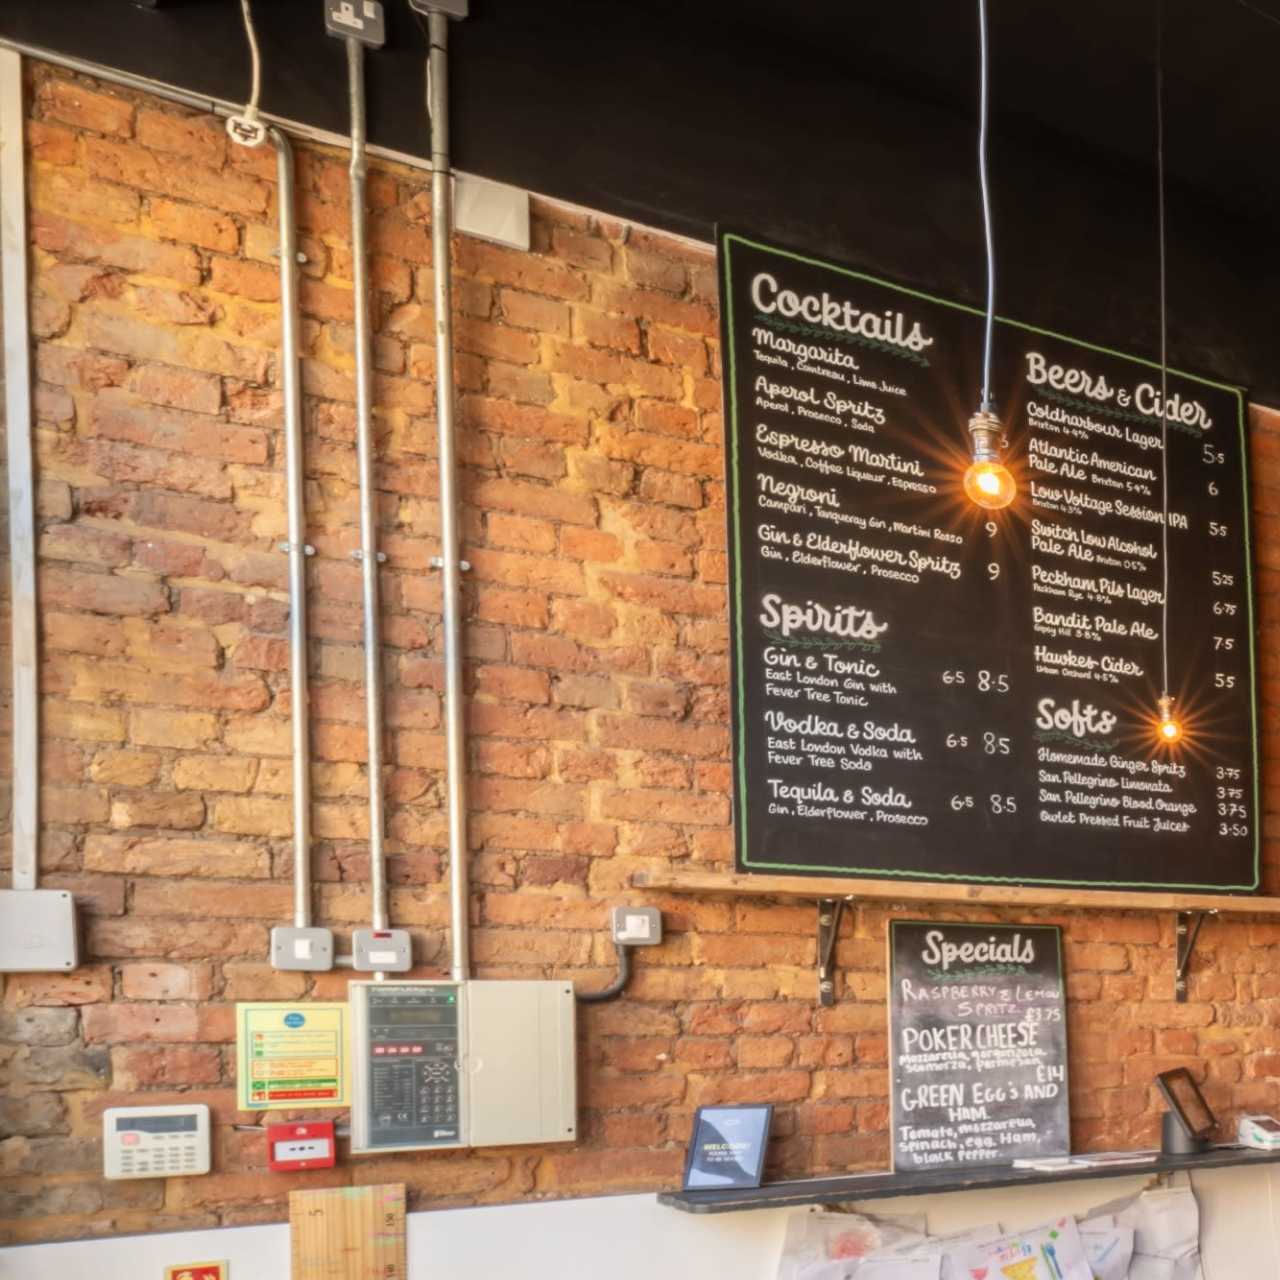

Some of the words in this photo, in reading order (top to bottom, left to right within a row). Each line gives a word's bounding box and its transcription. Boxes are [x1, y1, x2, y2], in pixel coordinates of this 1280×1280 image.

[752, 273, 933, 351] Cocktails
[752, 328, 859, 370] Margarita
[755, 376, 820, 404] Aperol
[824, 391, 886, 424] Spritz
[853, 375, 877, 390] Lime
[879, 381, 907, 396] Juice
[1026, 352, 1114, 400] Beers
[1117, 389, 1130, 406] &
[1135, 383, 1212, 430] Cider
[851, 418, 875, 433] Soda
[1027, 401, 1123, 438] Coldharbour
[1125, 427, 1165, 450] Lager
[1028, 418, 1060, 433] Brixton
[756, 424, 844, 457] Espresso
[849, 445, 924, 477] Martini
[1029, 438, 1089, 465] Atlantic
[1091, 452, 1157, 481] American
[805, 456, 843, 474] Coffee
[892, 476, 937, 494] Espresso
[1029, 455, 1058, 474] Pale
[1060, 463, 1087, 480] Ale
[1091, 474, 1124, 489] Brixton
[757, 473, 840, 507] Negroni
[1208, 481, 1219, 496] 6
[1030, 481, 1062, 500] Low
[1063, 489, 1113, 515] Voltage
[1115, 500, 1166, 524] Session
[1168, 512, 1188, 530] IPA
[814, 505, 867, 529] Tanqueray
[893, 522, 930, 538] Martini
[934, 529, 963, 544] Rosso
[985, 521, 997, 538] 9
[1031, 519, 1080, 543] Switch
[1080, 529, 1106, 548] Low
[1107, 536, 1157, 560] Alcohol
[758, 524, 790, 544] Gin
[793, 532, 803, 546] &
[806, 532, 907, 566] Elderflower
[909, 550, 962, 579] Spritz
[1031, 536, 1064, 555] Pale
[1068, 544, 1095, 562] Ale
[871, 564, 919, 583] Prosecco
[988, 563, 1000, 580] 9
[1032, 565, 1098, 593] Peckham
[1100, 578, 1125, 598] Pils
[1126, 583, 1165, 606] Lager
[760, 594, 888, 640] Spirits
[1033, 606, 1092, 630] Bandit
[1094, 616, 1128, 636] Pale
[1130, 622, 1159, 640] Ale
[764, 647, 801, 668] Gin
[805, 655, 818, 669] &
[823, 654, 880, 677] Tonic
[1034, 645, 1099, 670] Hawkes
[1101, 656, 1144, 677] Cider
[765, 668, 792, 681] East
[797, 671, 839, 687] London
[843, 678, 865, 691] Gin
[869, 682, 897, 694] with
[766, 683, 800, 698] Fever
[804, 688, 831, 703] Tree
[833, 691, 869, 706] Tonic
[764, 710, 844, 738] Vodka
[847, 723, 860, 739] &
[863, 721, 916, 743] Soda
[1036, 698, 1117, 737] Softs
[767, 737, 796, 750] East
[801, 739, 846, 755] London
[850, 744, 888, 758] Vodka
[893, 748, 923, 760] with
[768, 751, 803, 765] Fever
[807, 755, 835, 768] Tree
[840, 758, 872, 771] Soda
[1037, 747, 1108, 767] Homemade
[1109, 755, 1149, 774] Ginger
[1151, 760, 1186, 778] Spritz
[767, 779, 839, 805] Tequila
[843, 789, 854, 803] &
[861, 786, 912, 808] Soda
[1038, 771, 1061, 783] San
[1063, 771, 1119, 789] Pellegrino
[1121, 777, 1173, 793] Limonata
[876, 811, 928, 825] Prosecco
[1038, 789, 1062, 802] San
[1064, 790, 1120, 809] Pellegrino
[1123, 796, 1155, 811] Blood
[1155, 799, 1197, 816] Orange
[1079, 813, 1120, 827] Pressed
[1123, 815, 1150, 829] Fruit
[1153, 816, 1190, 832] Juices
[922, 930, 1035, 970] Specials
[903, 1025, 973, 1053] POKER
[976, 1021, 1040, 1049] CHEESE
[1036, 1064, 1064, 1082] £14
[901, 1083, 964, 1111] GREEN
[1023, 1084, 1059, 1100] AND
